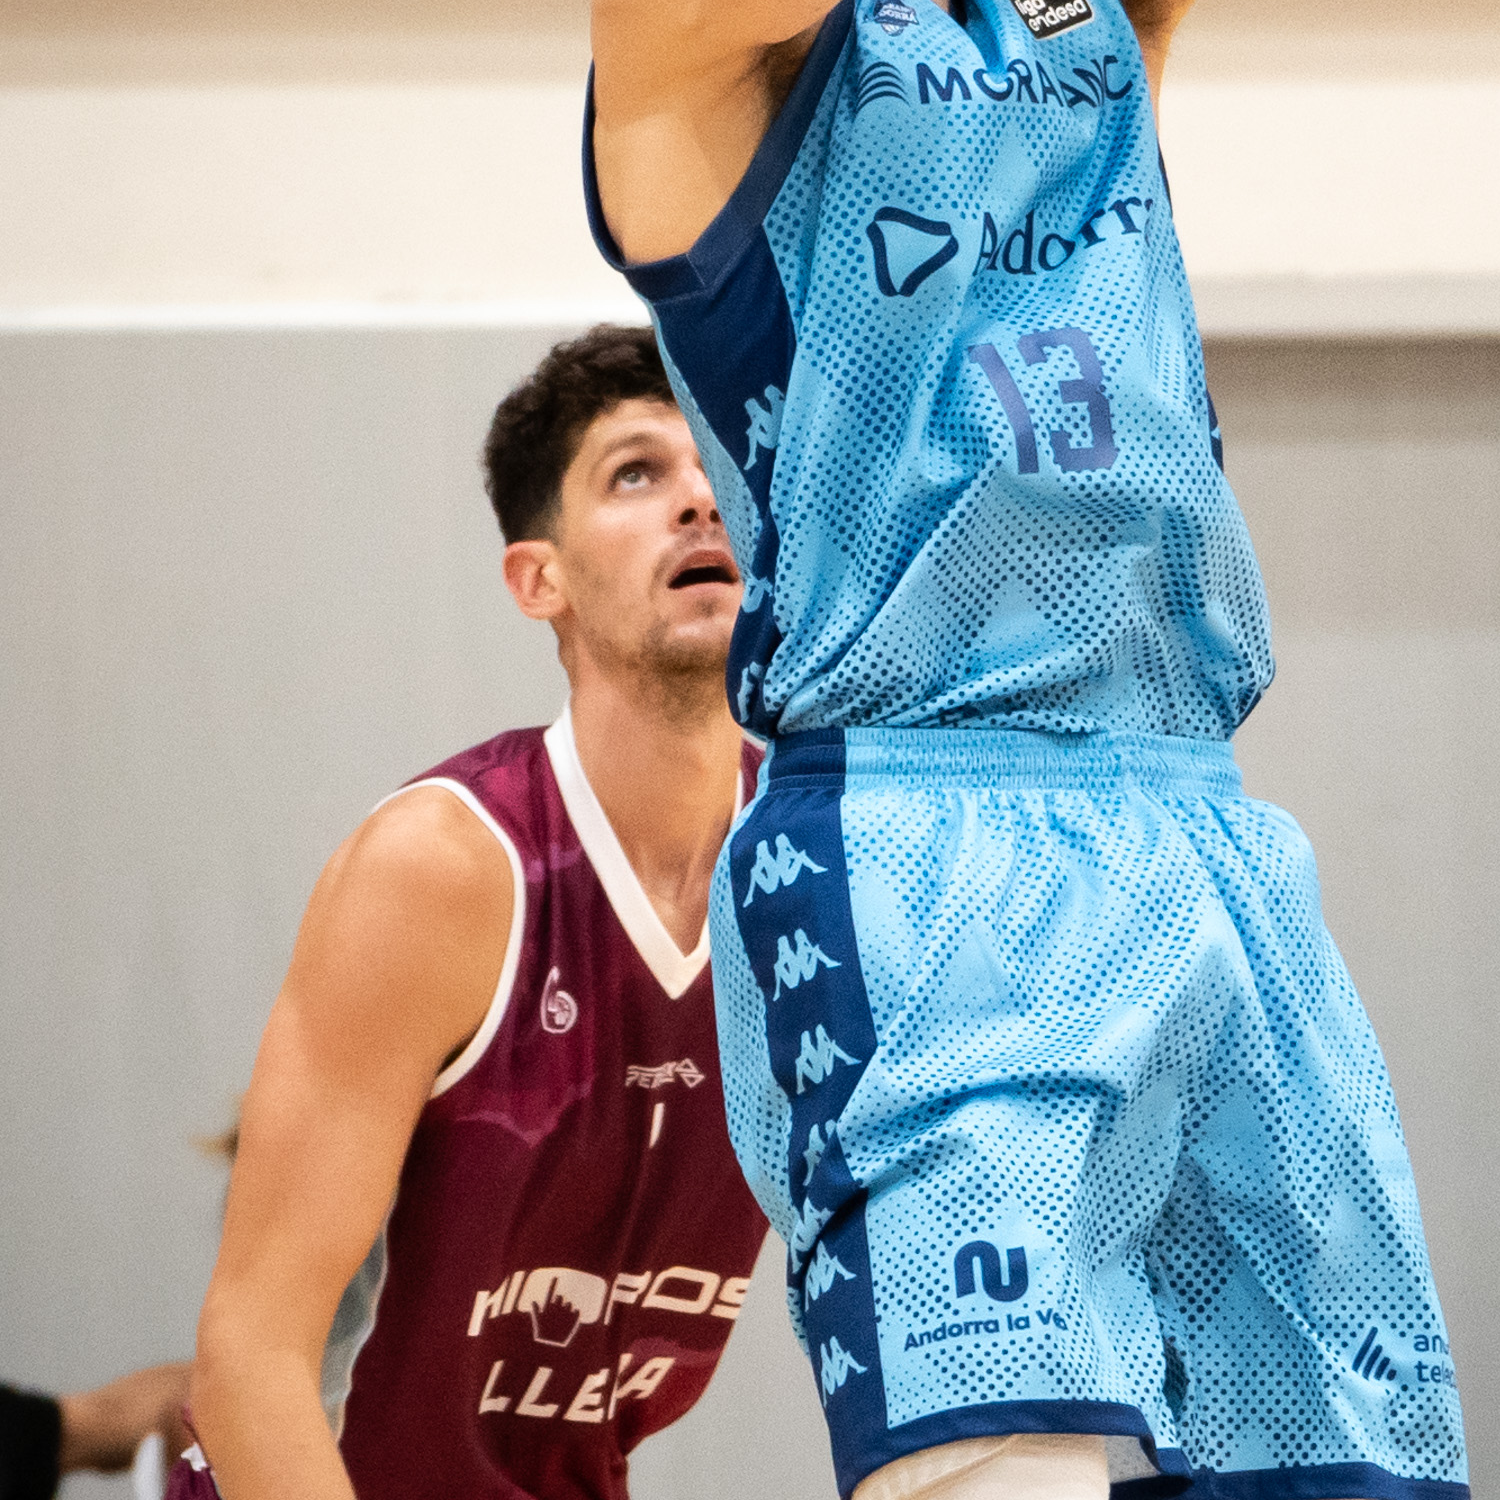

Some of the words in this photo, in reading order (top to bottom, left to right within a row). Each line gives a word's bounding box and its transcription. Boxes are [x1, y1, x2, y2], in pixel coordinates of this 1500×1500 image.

[972, 196, 1154, 277] Adorr
[967, 326, 1120, 475] 13
[904, 1320, 1000, 1351] Andorra
[1006, 1312, 1031, 1332] la
